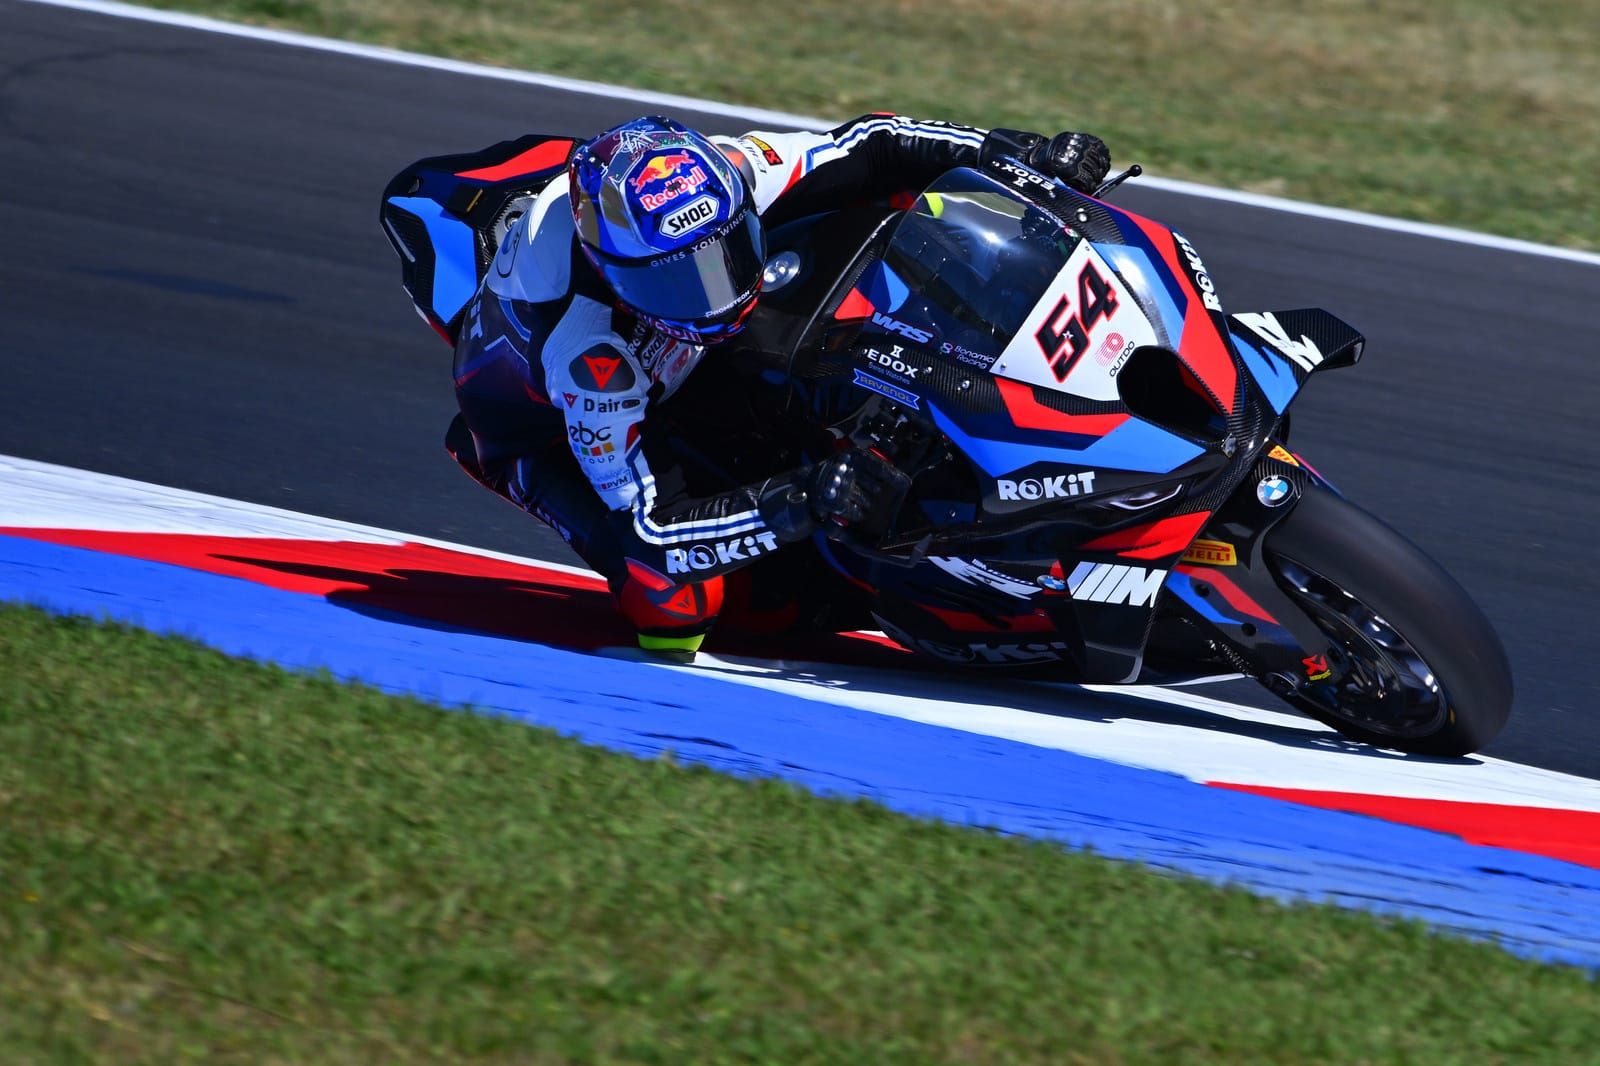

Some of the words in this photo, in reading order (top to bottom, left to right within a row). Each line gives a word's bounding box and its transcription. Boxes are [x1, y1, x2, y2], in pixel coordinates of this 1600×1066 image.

[641, 181, 678, 211] Red
[676, 166, 707, 194] Bull
[1001, 164, 1055, 190] EDOX
[668, 201, 712, 233] SHOEI
[651, 251, 686, 268] GIVES
[692, 236, 716, 253] YOU
[720, 209, 748, 236] WINGS
[872, 312, 934, 344] WRS
[1034, 258, 1120, 383] 54
[867, 349, 918, 378] EDOX
[1109, 341, 1135, 377] OUTDO
[568, 421, 612, 445] ebc
